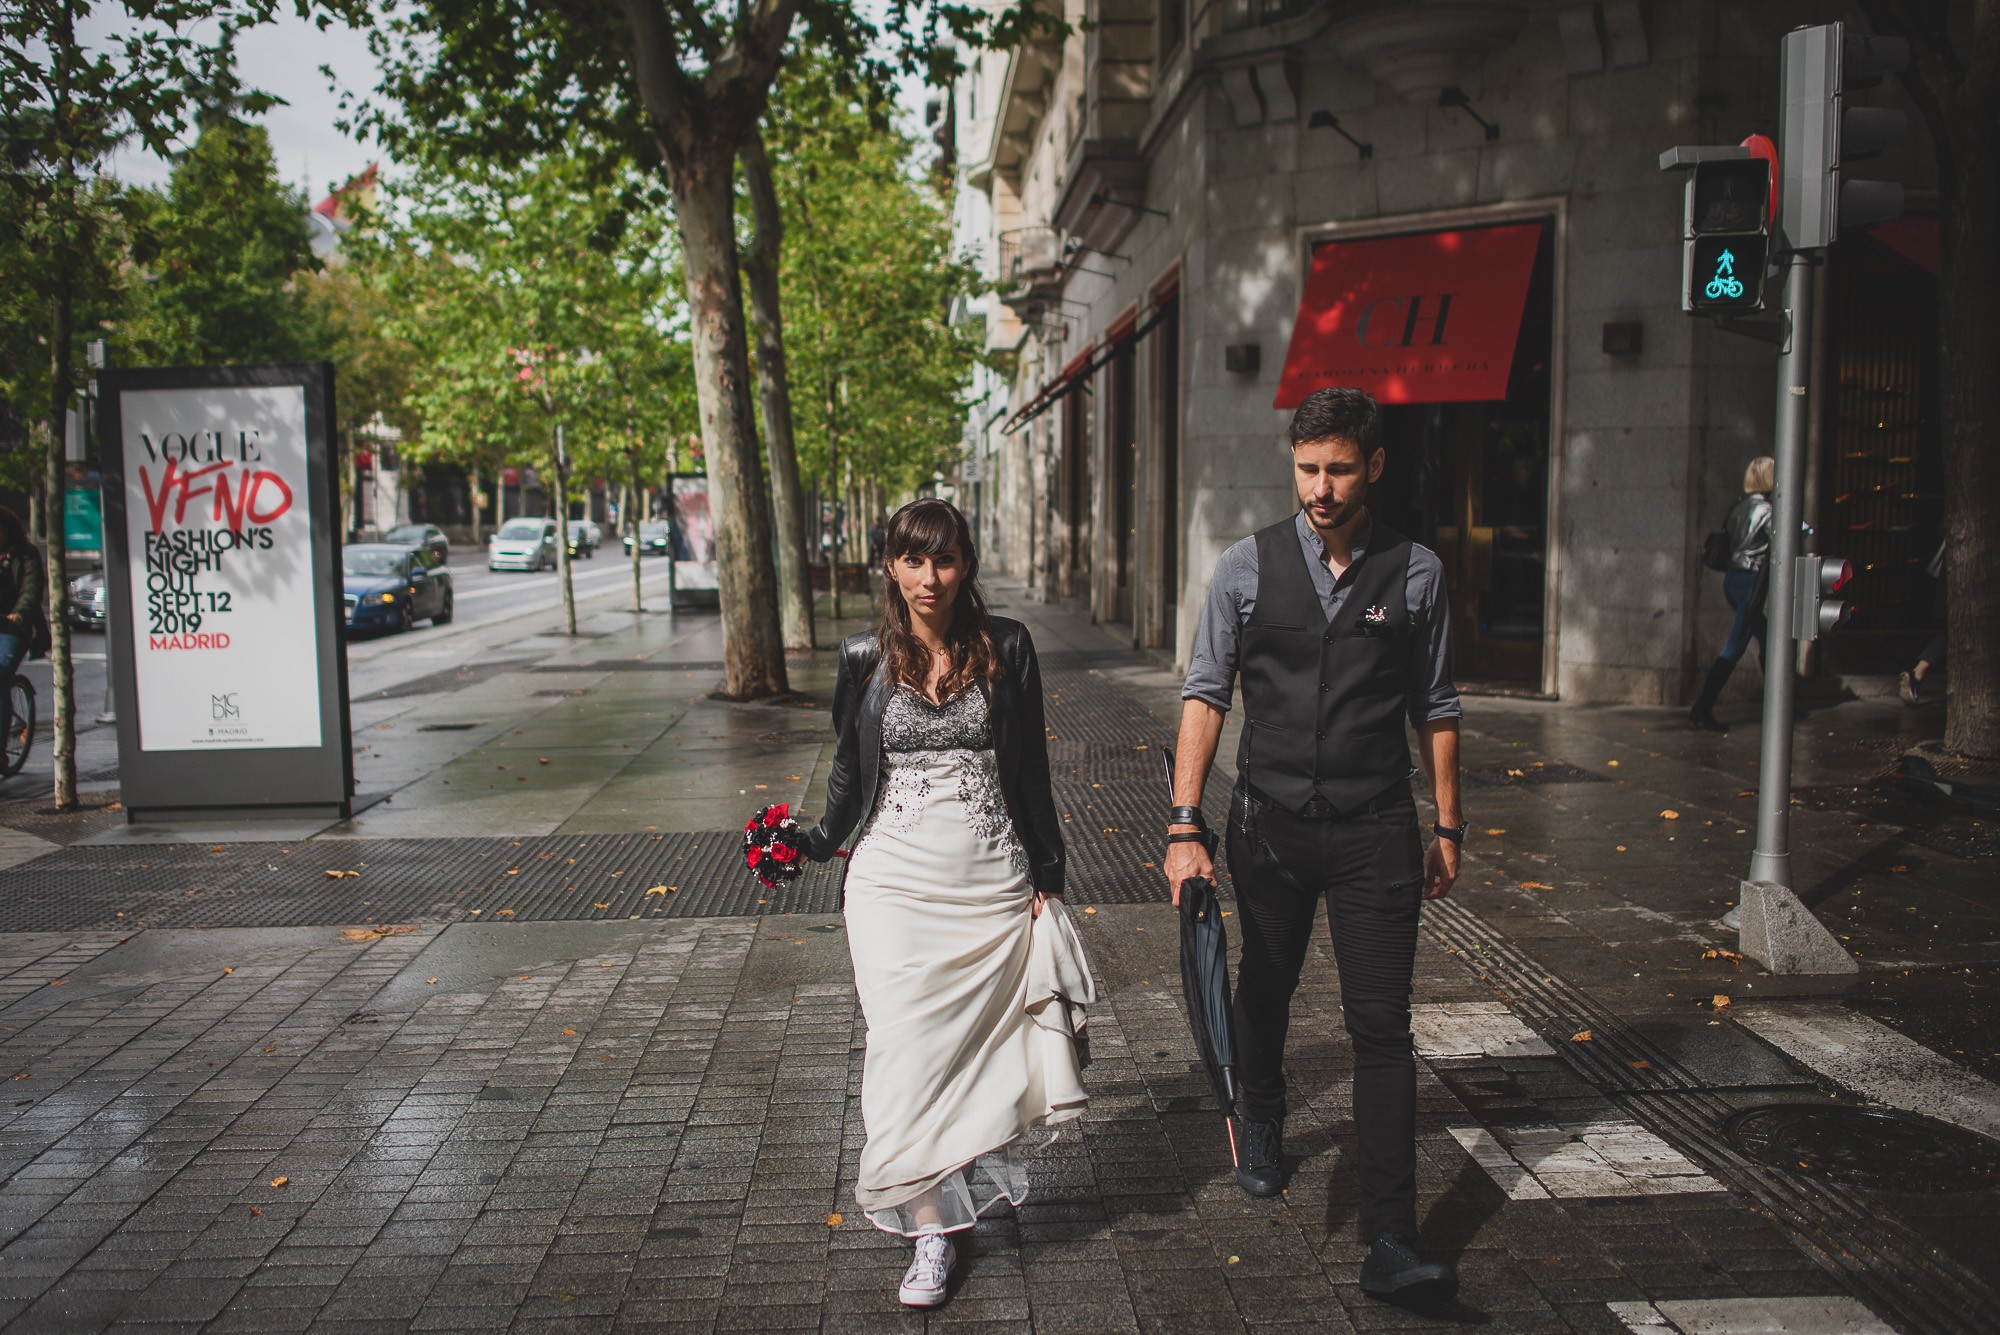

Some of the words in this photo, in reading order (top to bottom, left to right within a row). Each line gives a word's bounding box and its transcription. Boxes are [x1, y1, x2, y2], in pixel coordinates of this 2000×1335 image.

[1356, 293, 1458, 350] CH
[138, 430, 262, 464] VOGUE
[138, 455, 294, 547] VFNO
[144, 527, 274, 553] FASHION'S
[146, 550, 224, 573] NIGHT
[147, 571, 199, 596] OUT
[149, 612, 203, 634] 2019
[149, 632, 231, 650] MADRID
